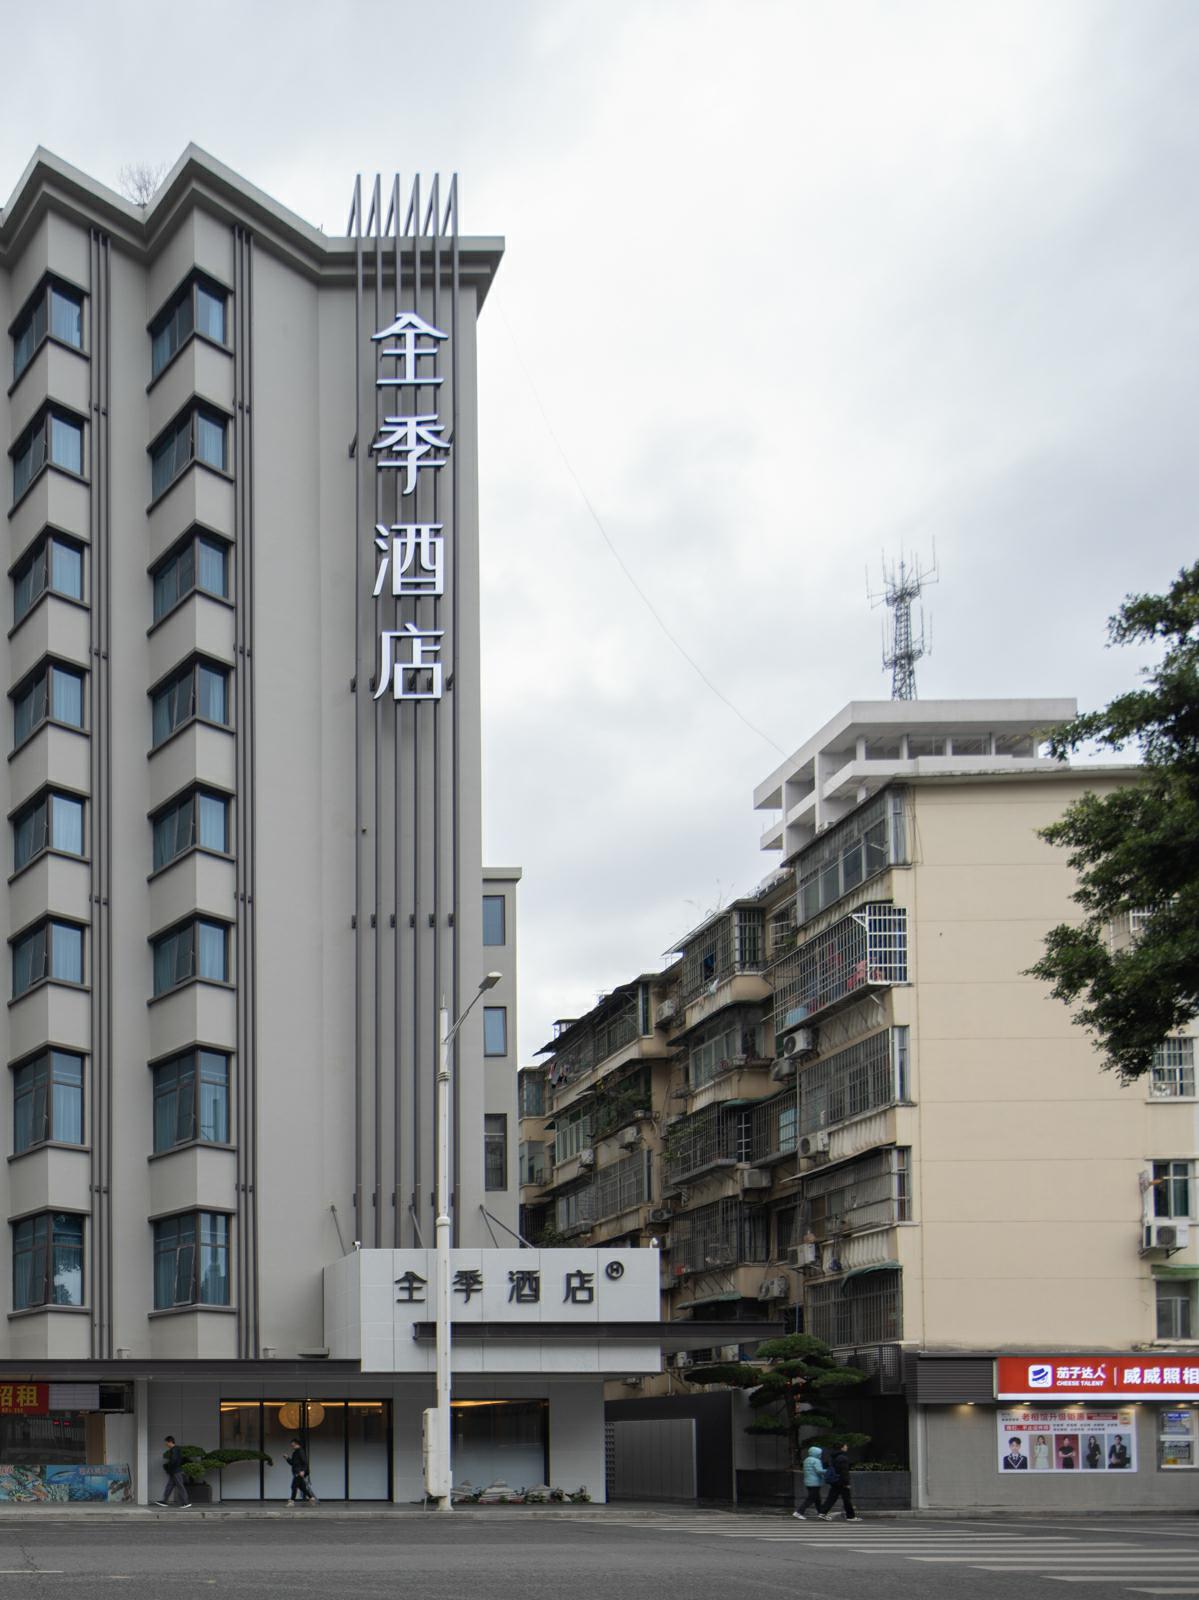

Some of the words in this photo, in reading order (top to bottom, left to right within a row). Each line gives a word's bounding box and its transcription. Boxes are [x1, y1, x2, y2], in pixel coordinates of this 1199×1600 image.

[371, 312, 450, 701] 全季酒店
[394, 1269, 595, 1305] 全季酒店
[1056, 1366, 1106, 1380] 茄子达人
[1123, 1366, 1199, 1385] 威威照相
